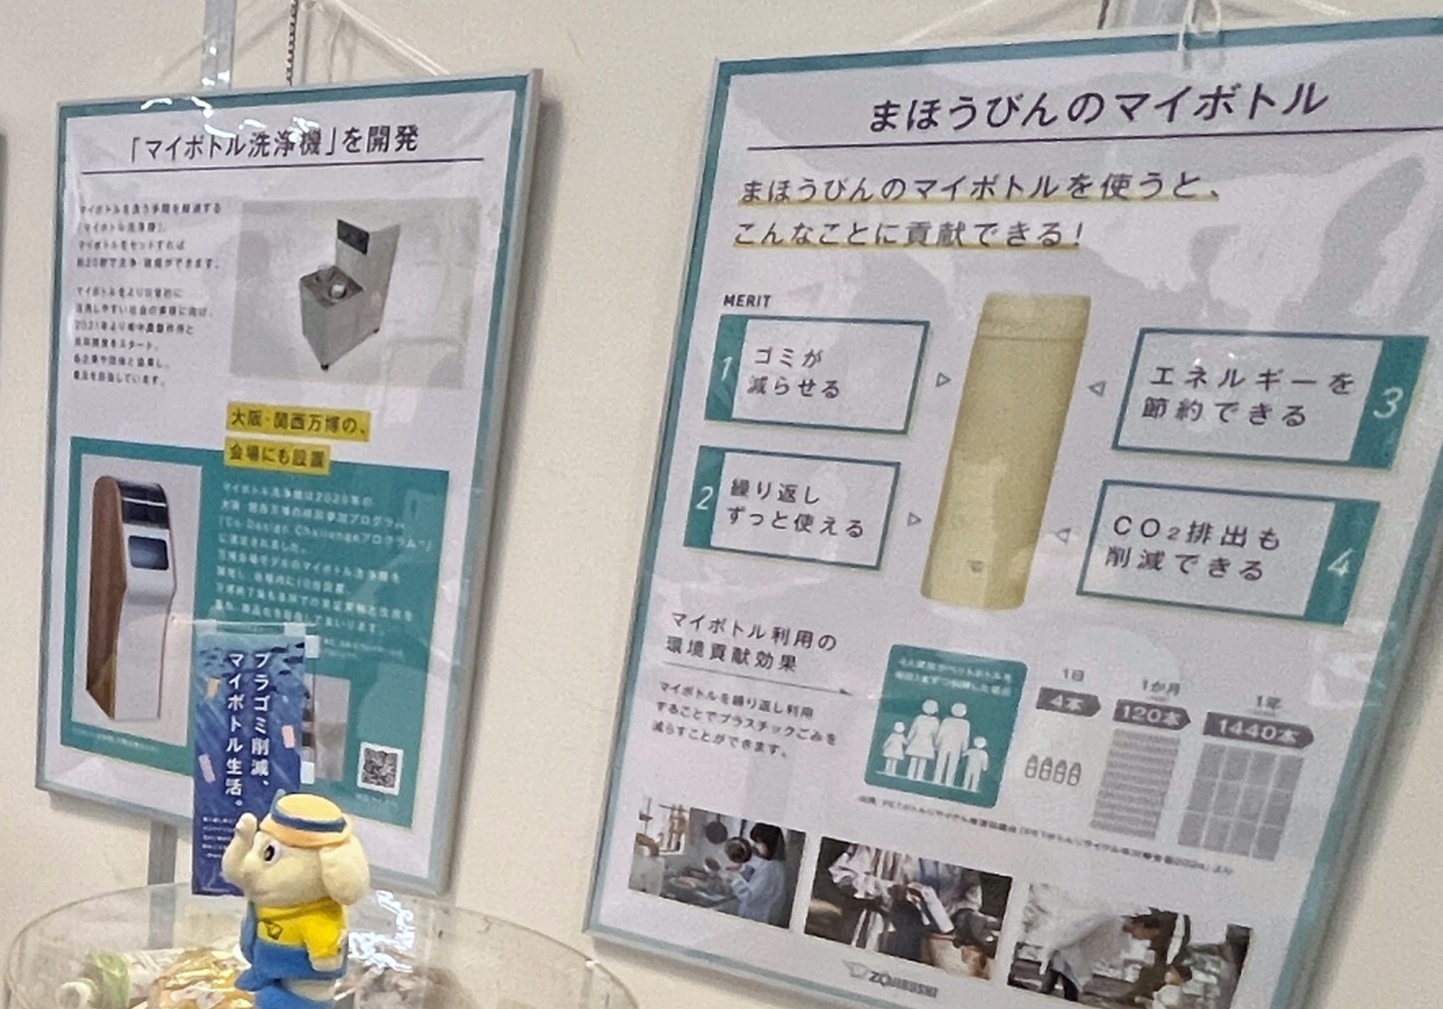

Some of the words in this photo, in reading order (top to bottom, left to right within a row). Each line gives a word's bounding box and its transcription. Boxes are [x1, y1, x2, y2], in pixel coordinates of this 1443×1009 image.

[869, 81, 1329, 133] まほうびんのマイボトル
[130, 124, 419, 163] 「マイボトル洗浄機」を開発
[740, 172, 1221, 205] まほうびんのマイボトルを使うと、
[722, 294, 771, 308] MERIT
[720, 356, 733, 382] 1
[754, 347, 824, 368] ゴミが
[746, 375, 841, 399] 減らせる
[1150, 366, 1356, 396] エネルギーを
[1141, 396, 1308, 427] 節約できる
[1373, 387, 1405, 420] 3
[229, 444, 325, 468] 会場にも設置
[695, 486, 714, 511] 2
[730, 478, 821, 505] 繰り返し
[727, 505, 864, 538] ずっと使える
[1105, 545, 1264, 581] 削減できる
[1327, 547, 1355, 578] 4
[671, 611, 837, 652] マイボトル利用の
[665, 635, 798, 673] 環境貢献効果
[1062, 668, 1085, 682] 1日
[1049, 694, 1084, 712] 4本
[1120, 704, 1182, 726] 120本
[225, 653, 244, 807] マイボトル生活。
[250, 653, 270, 786] プラゴミ削減、
[1217, 719, 1299, 745] 1440本
